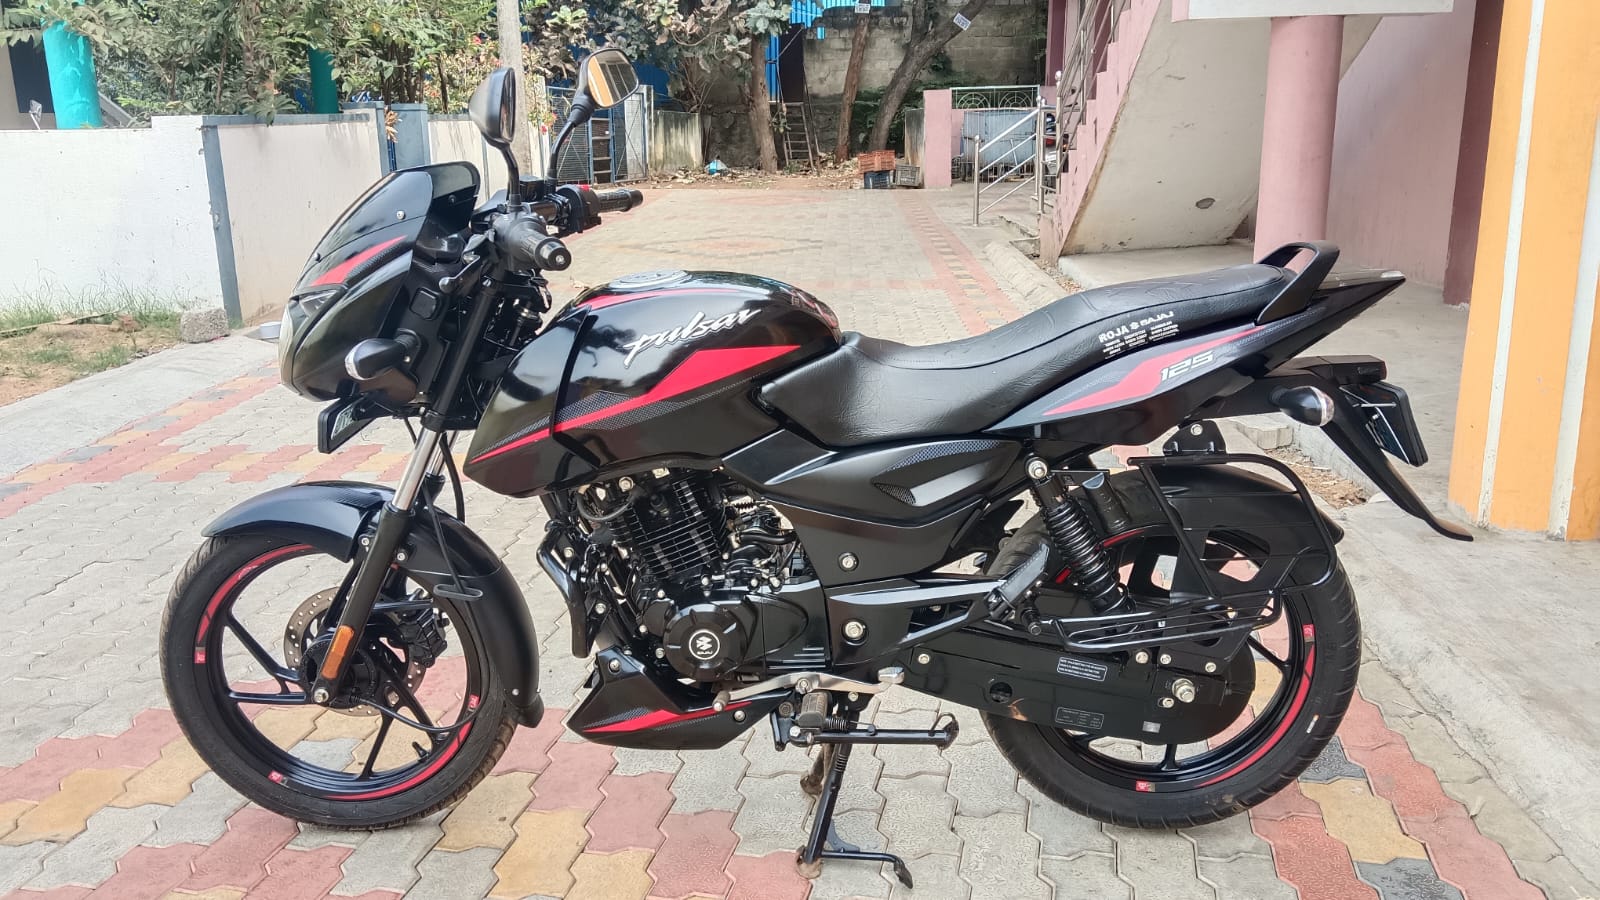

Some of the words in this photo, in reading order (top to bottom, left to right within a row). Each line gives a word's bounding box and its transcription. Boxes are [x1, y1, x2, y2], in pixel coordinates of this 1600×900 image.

[1099, 325, 1129, 342] ROJA
[1140, 311, 1174, 326] BAJAJ
[1161, 350, 1214, 381] 125
